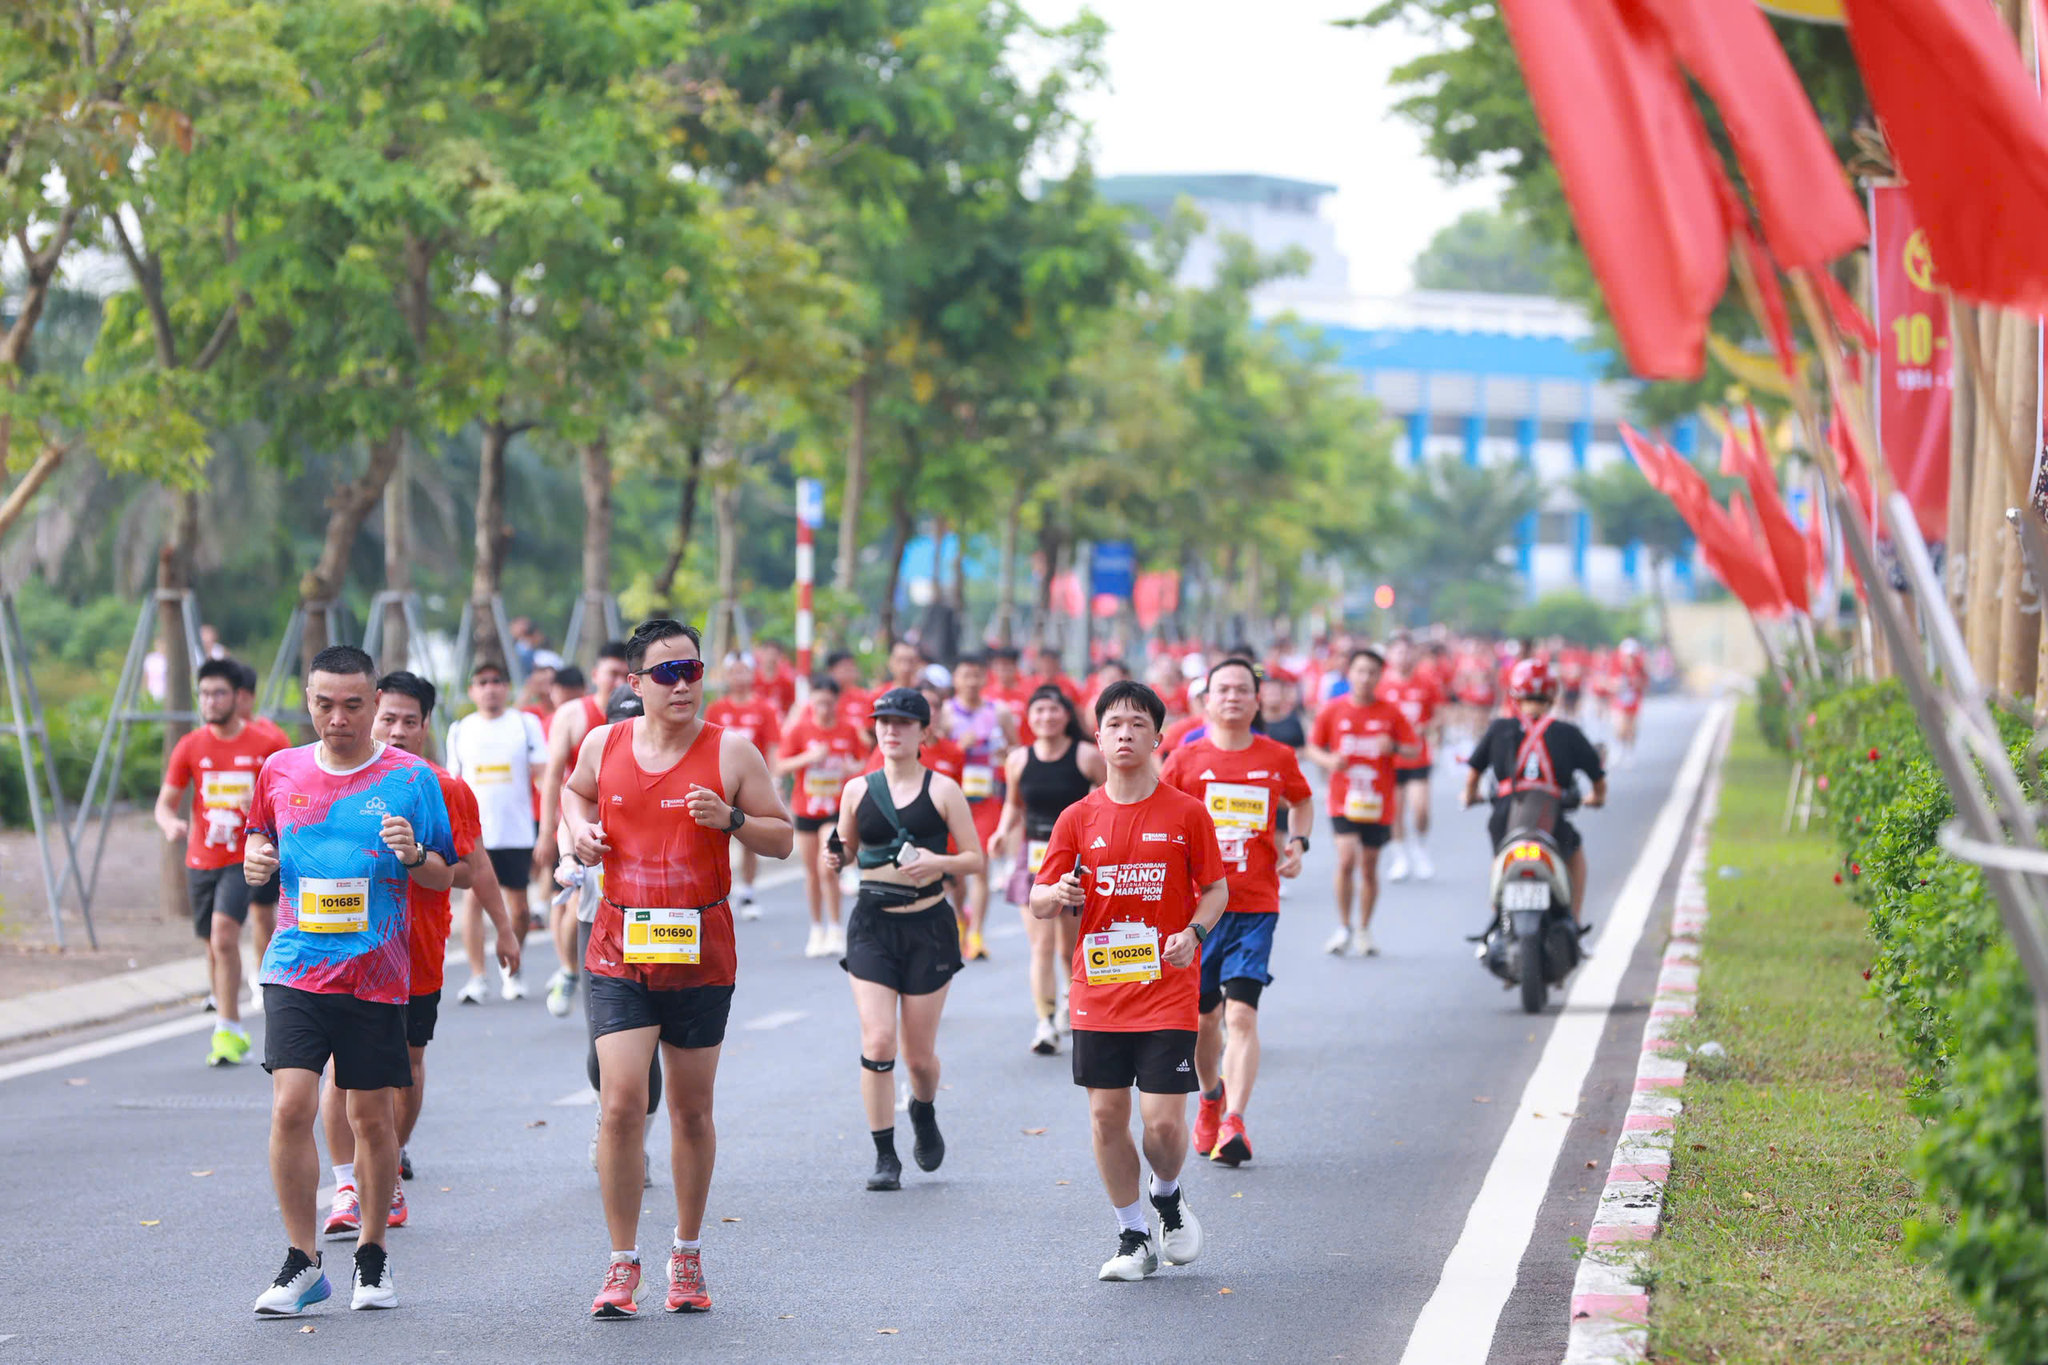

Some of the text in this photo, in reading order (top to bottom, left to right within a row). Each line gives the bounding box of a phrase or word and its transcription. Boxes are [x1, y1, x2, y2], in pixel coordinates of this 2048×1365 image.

[1213, 799, 1224, 811] C
[1095, 865, 1118, 897] 5
[1117, 868, 1166, 883] HANOI
[1114, 886, 1163, 896] MARATHON
[321, 896, 361, 908] 101685
[653, 927, 693, 938] 101690
[1092, 951, 1105, 965] C
[1111, 946, 1153, 959] 100206
